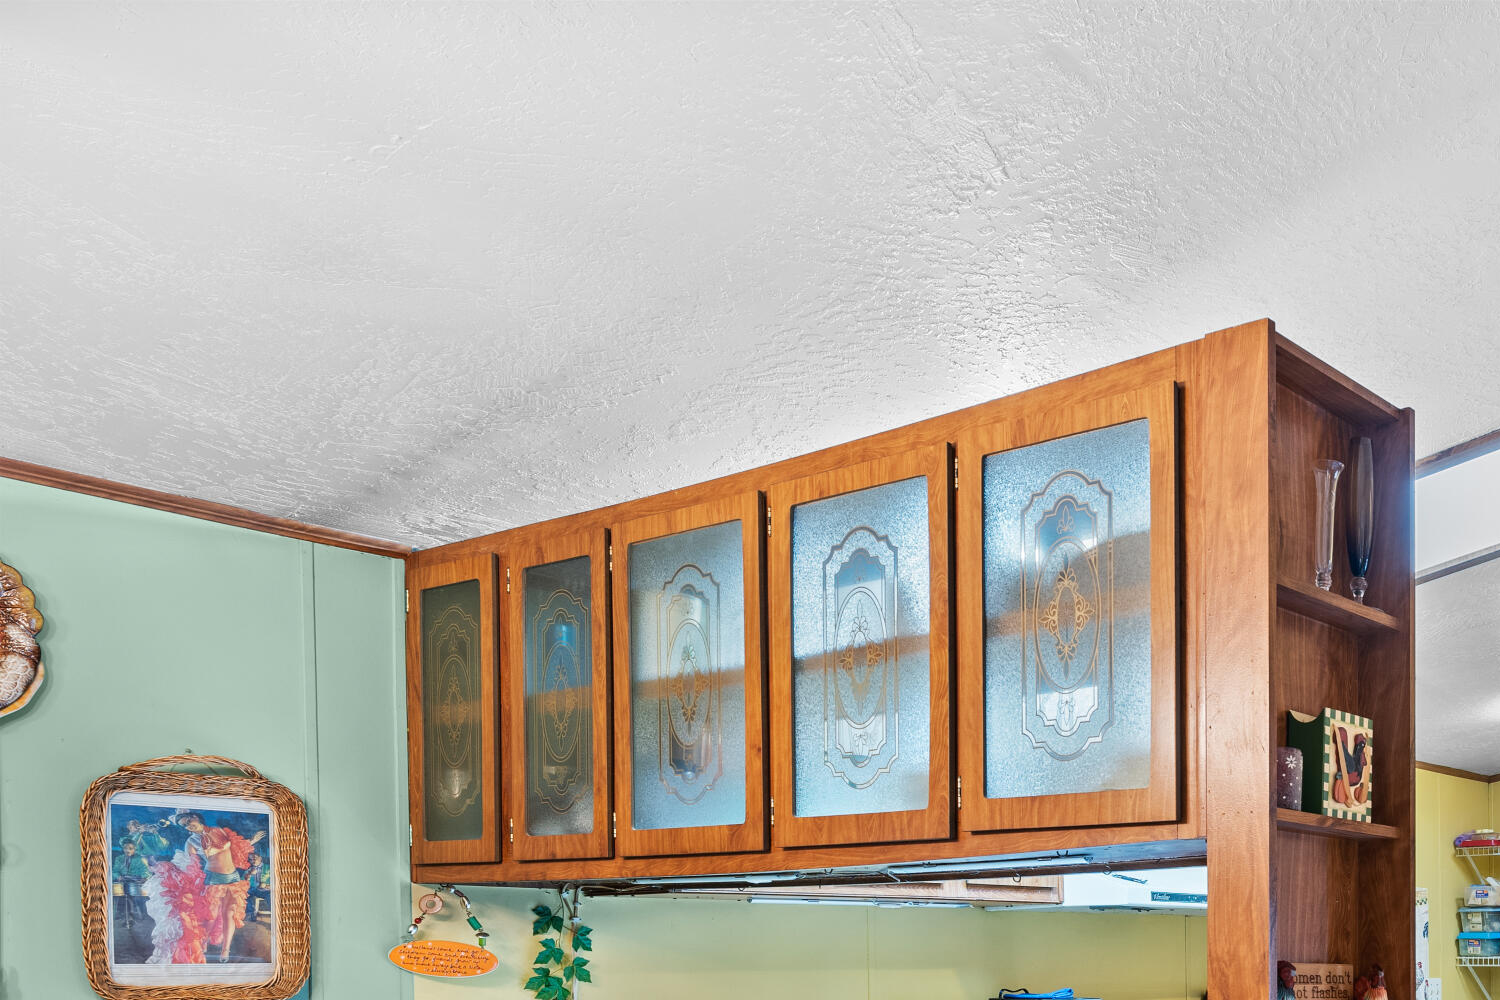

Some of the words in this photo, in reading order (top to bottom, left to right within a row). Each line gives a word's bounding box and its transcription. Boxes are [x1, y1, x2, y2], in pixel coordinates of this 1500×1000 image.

[1294, 974, 1322, 984] omen
[1325, 971, 1352, 984] don't
[1296, 986, 1309, 999] ot
